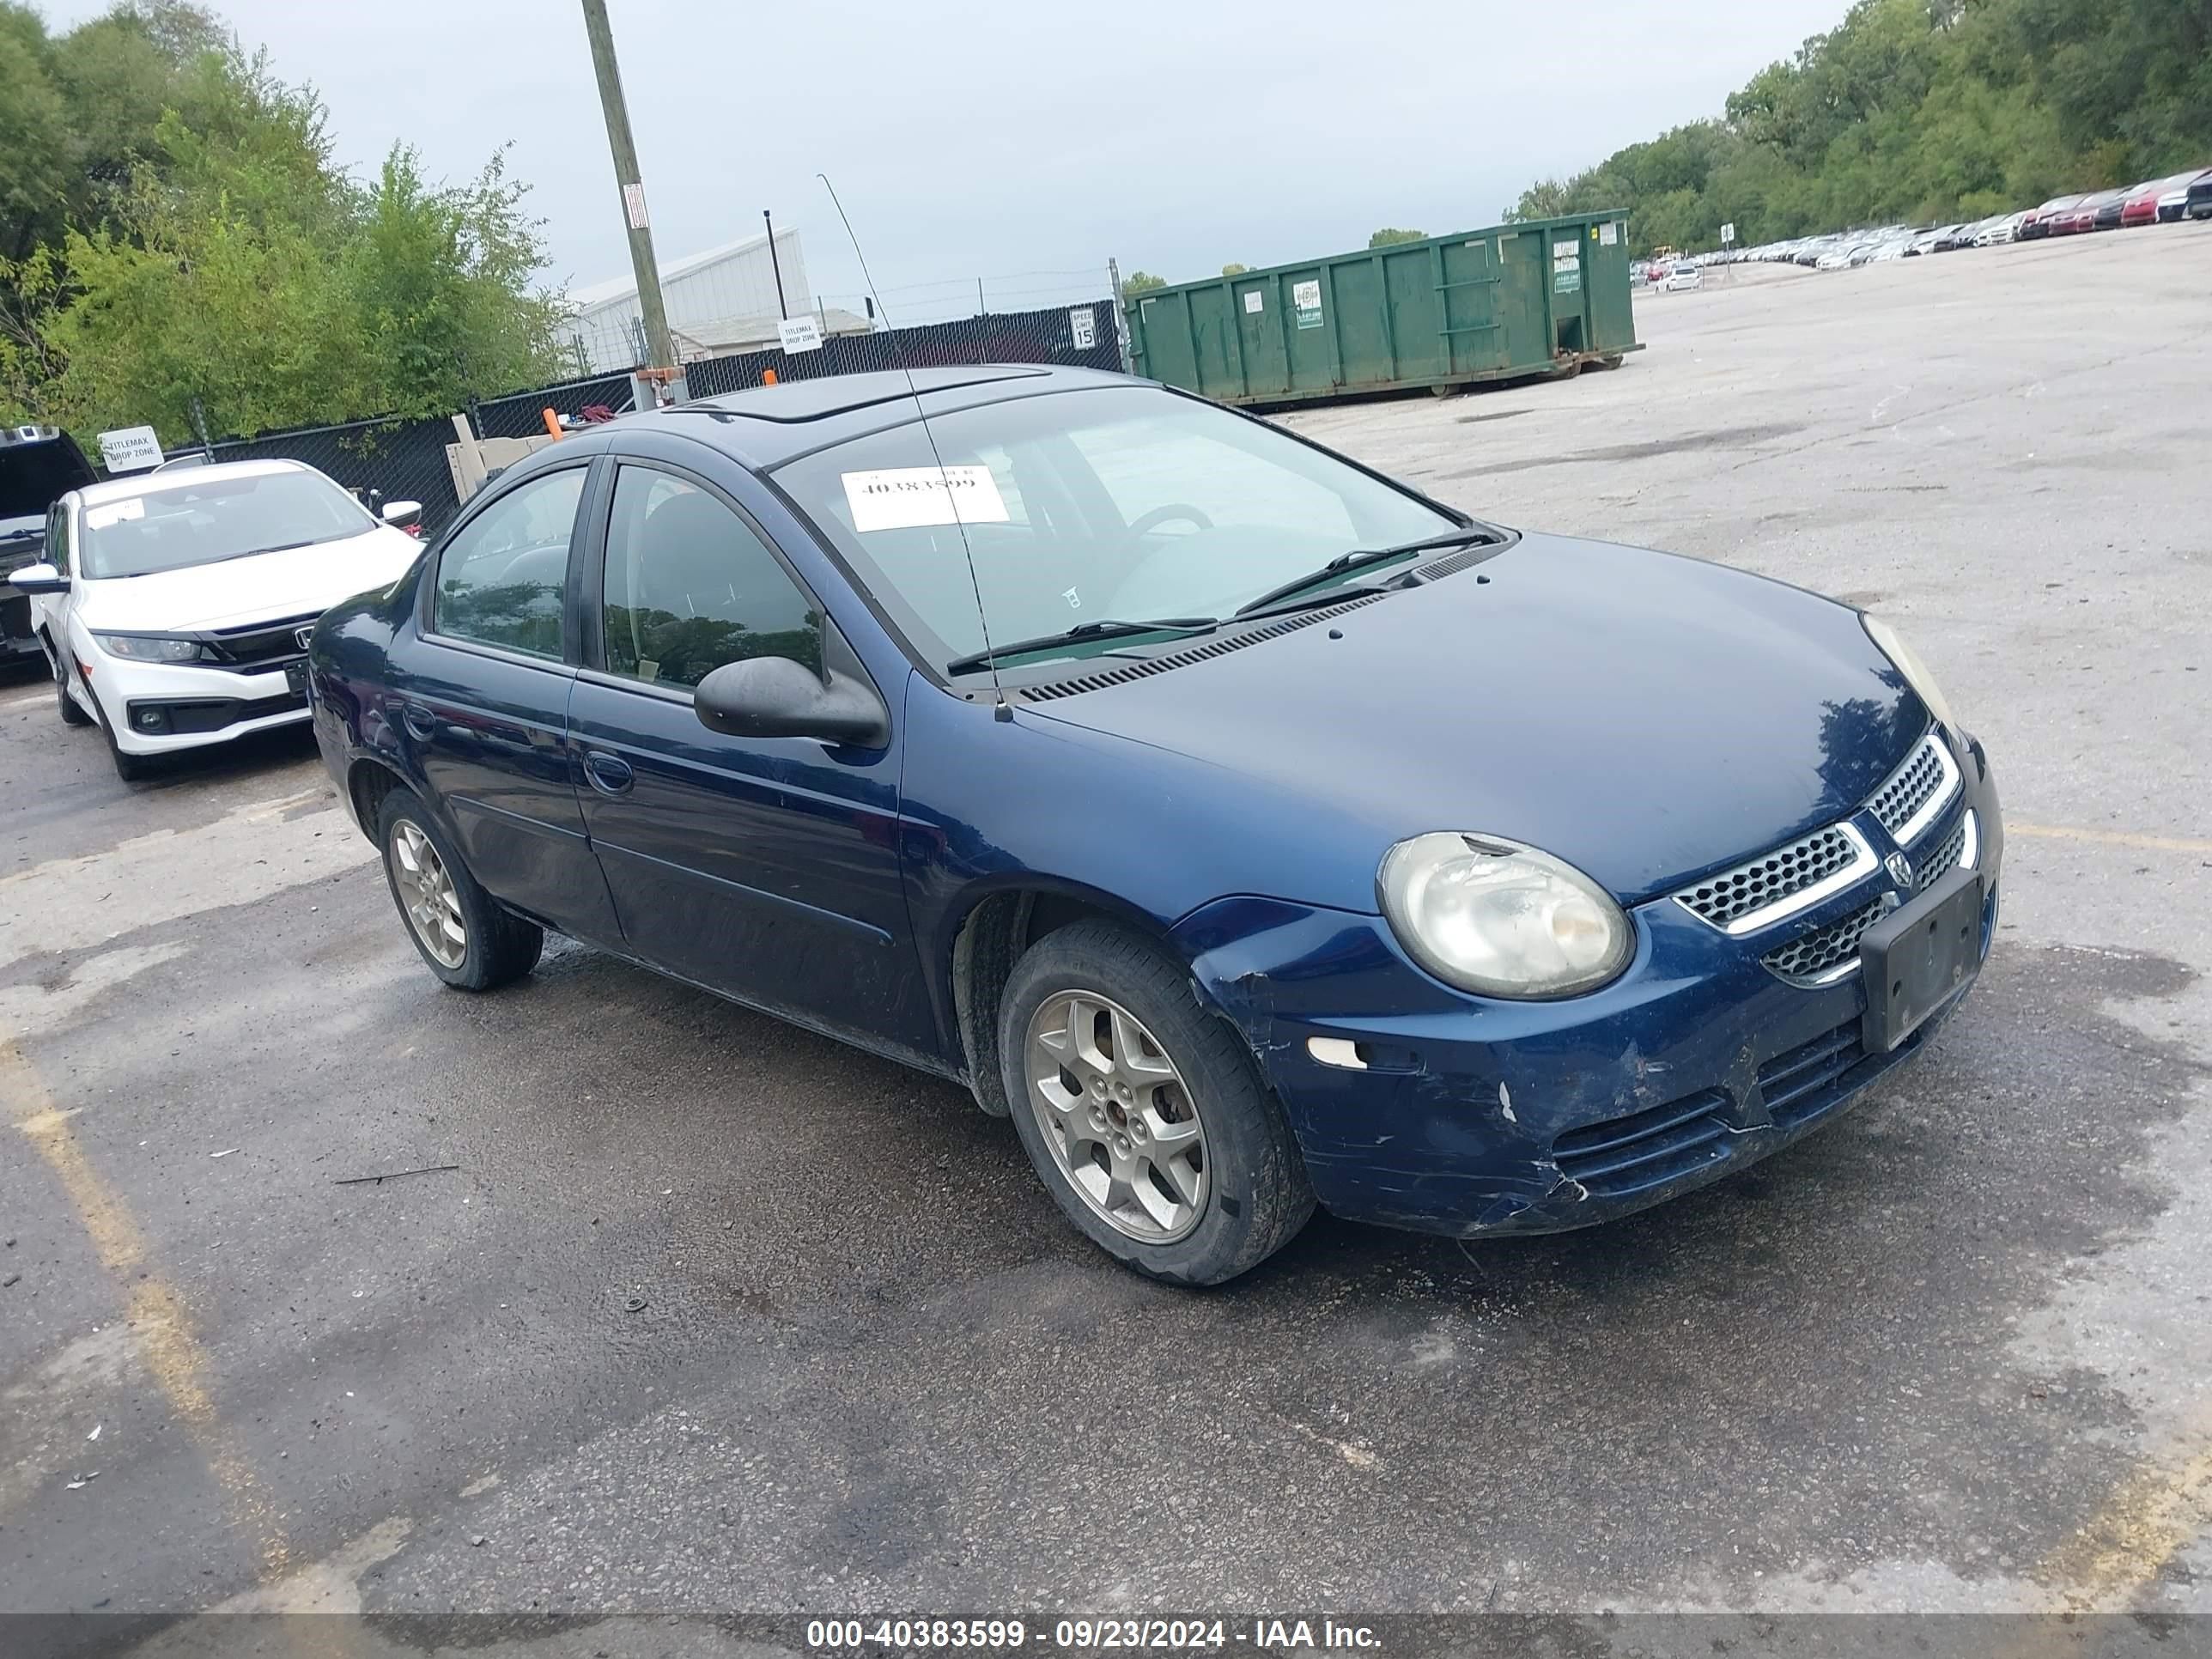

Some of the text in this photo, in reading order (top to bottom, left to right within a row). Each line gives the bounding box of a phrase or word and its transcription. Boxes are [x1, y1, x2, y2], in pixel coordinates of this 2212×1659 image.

[785, 325, 811, 337] TITLEMAX
[1079, 330, 1092, 344] 15
[109, 436, 149, 451] TITLEMAX
[110, 447, 155, 461] DROP ZONE
[861, 479, 975, 495] 40383599
